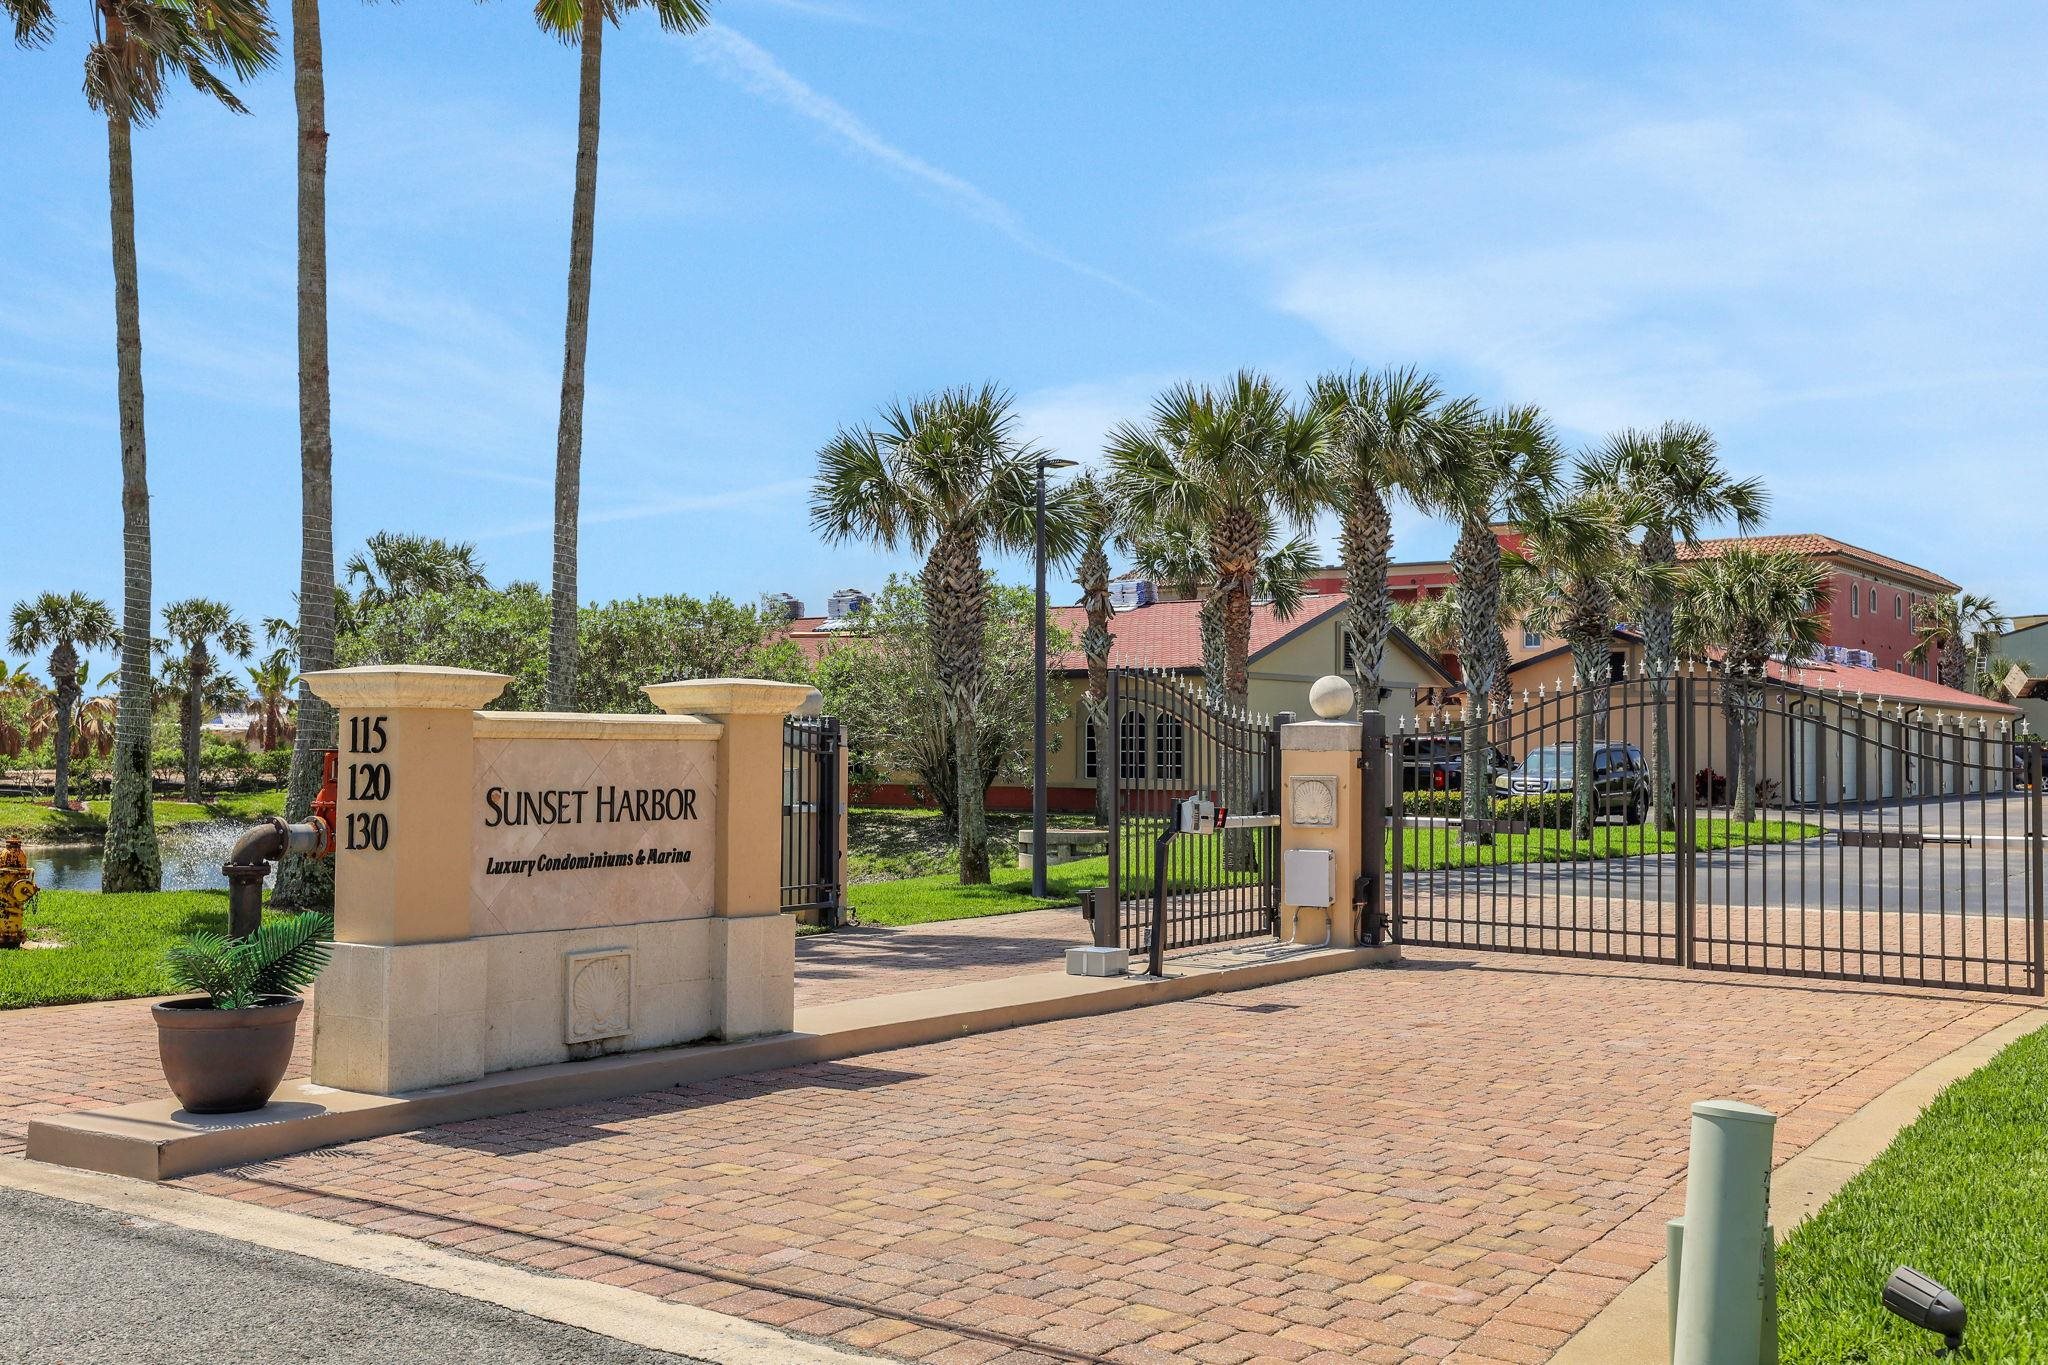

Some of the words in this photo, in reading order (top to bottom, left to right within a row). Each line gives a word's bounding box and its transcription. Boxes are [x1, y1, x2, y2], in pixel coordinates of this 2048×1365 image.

[349, 716, 388, 753] 115
[347, 763, 391, 801] 120
[485, 787, 589, 827] SUNSET
[595, 785, 698, 823] HARBOR
[345, 812, 389, 851] 130
[486, 857, 536, 877] Luxury
[537, 851, 633, 872] Condominiums
[635, 849, 646, 865] &
[647, 848, 691, 864] Marina
